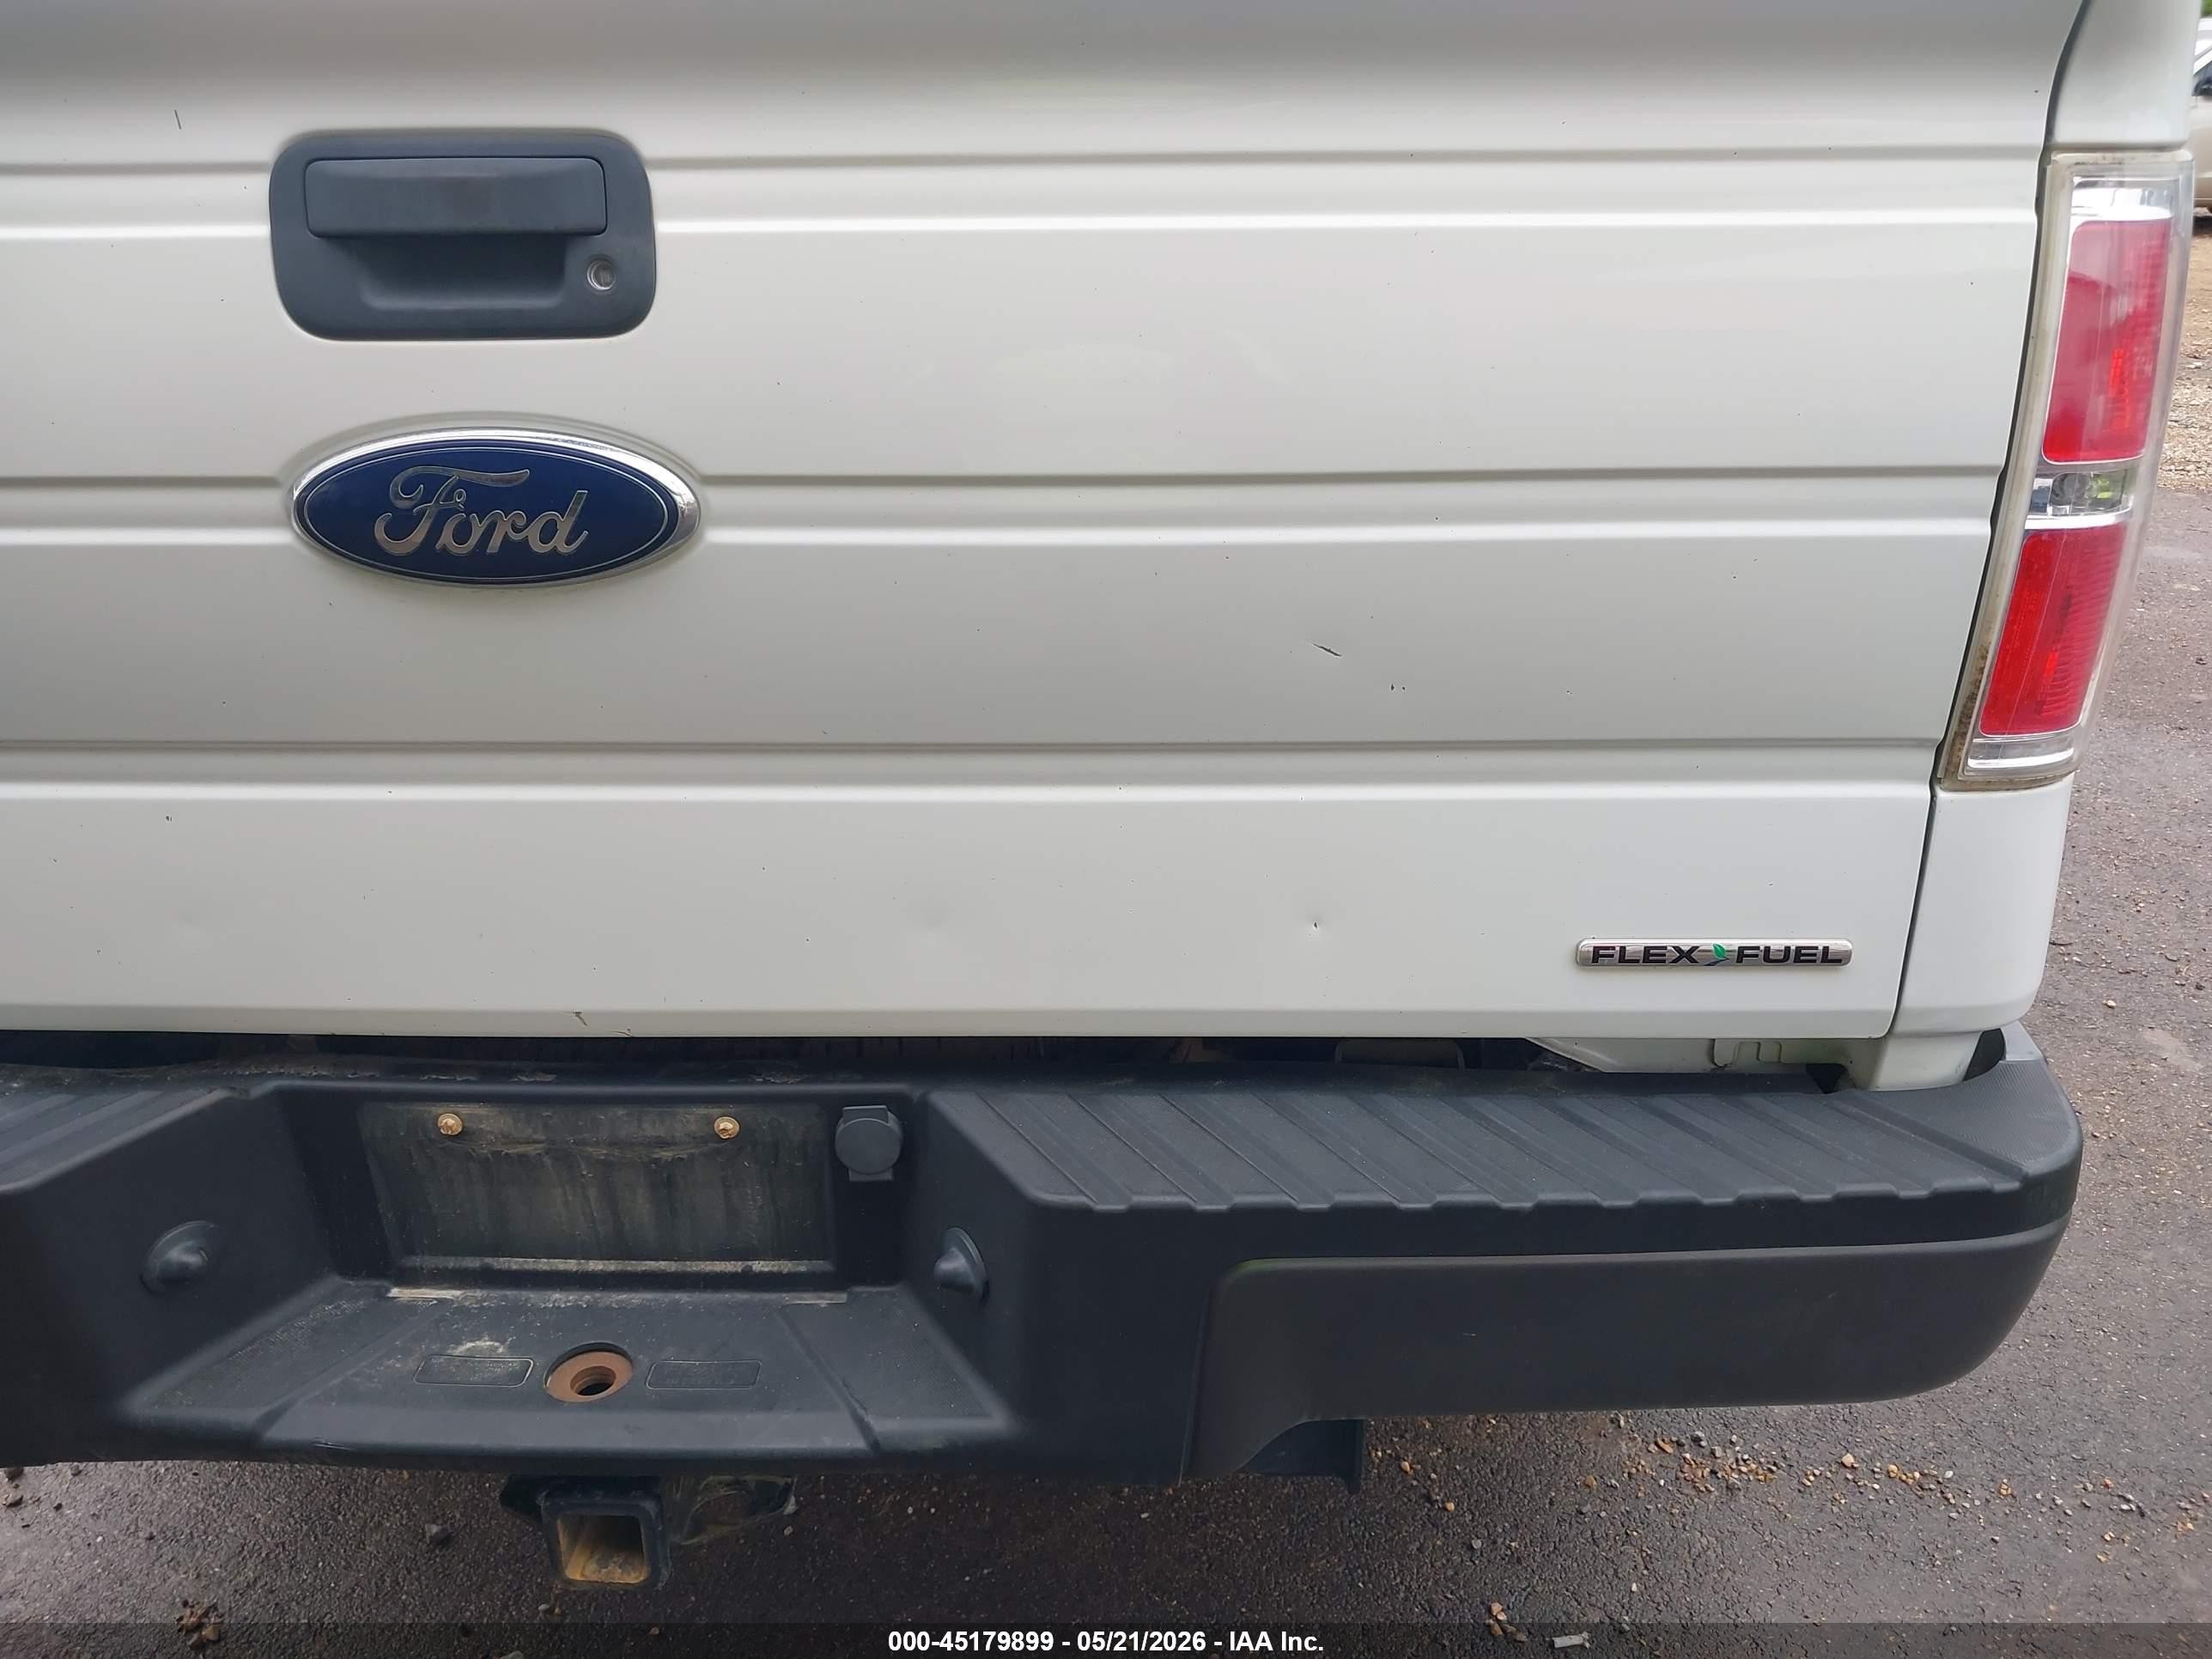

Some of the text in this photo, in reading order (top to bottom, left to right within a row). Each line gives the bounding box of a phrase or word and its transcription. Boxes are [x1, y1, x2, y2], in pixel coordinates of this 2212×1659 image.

[374, 465, 588, 556] Ford
[1591, 945, 1844, 964] FLEX FUEL
